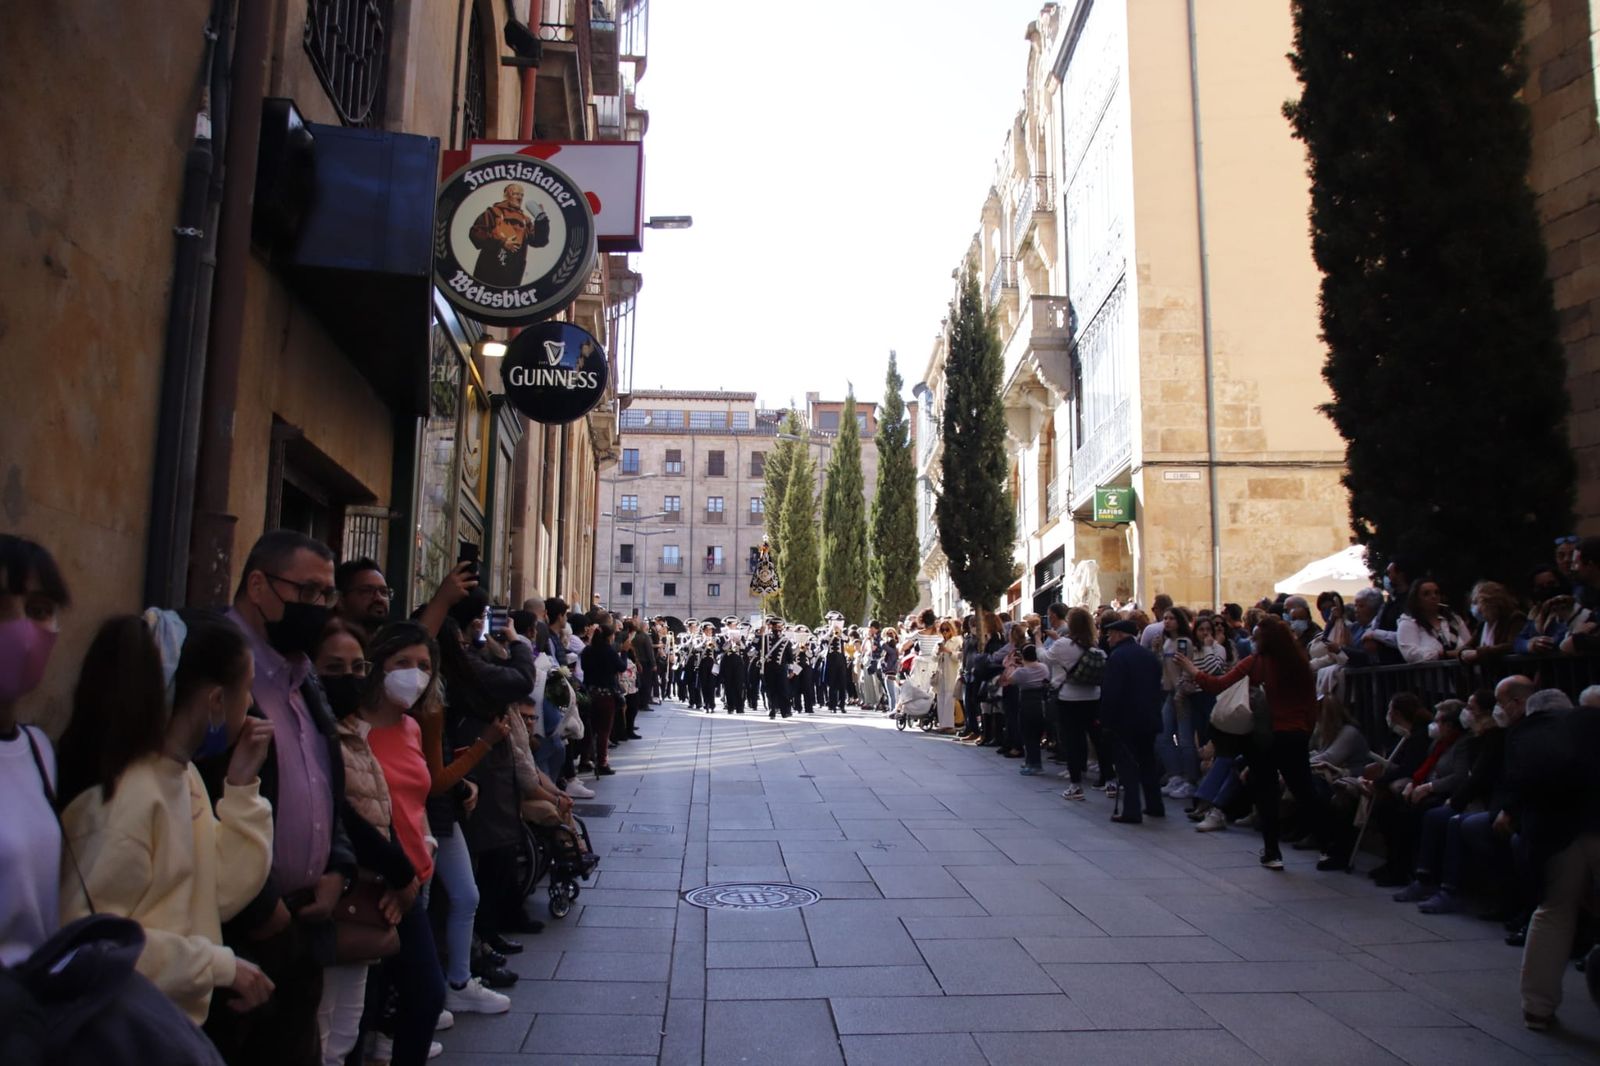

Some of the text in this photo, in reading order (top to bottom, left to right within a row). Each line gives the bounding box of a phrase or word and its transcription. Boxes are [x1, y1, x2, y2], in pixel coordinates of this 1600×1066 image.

[463, 161, 576, 209] Franziskaner
[449, 269, 538, 308] Weissbier
[509, 366, 598, 389] GUINNESS
